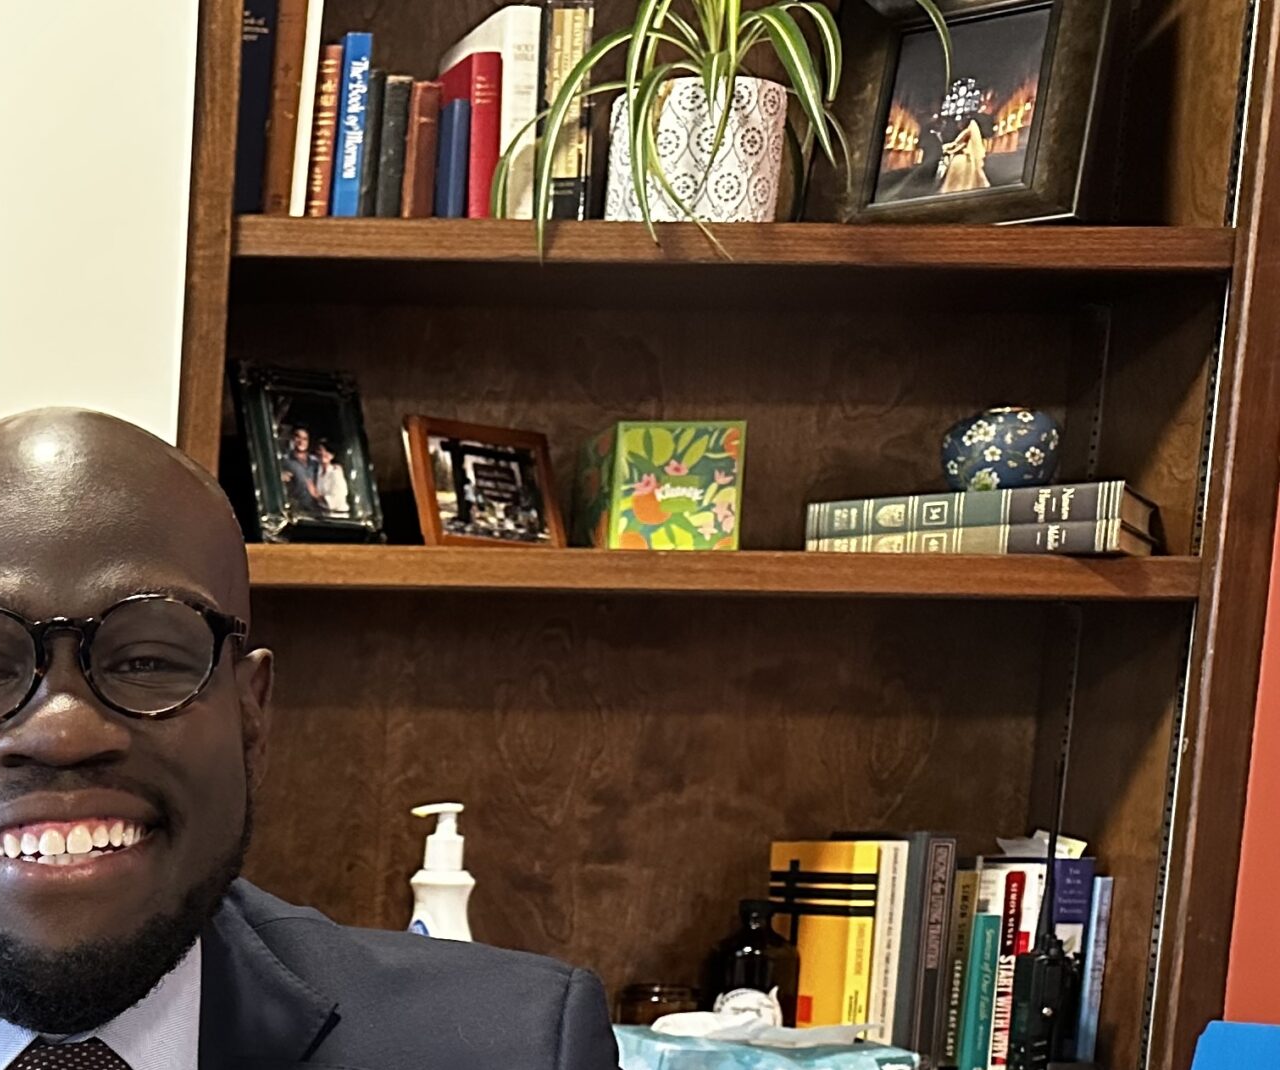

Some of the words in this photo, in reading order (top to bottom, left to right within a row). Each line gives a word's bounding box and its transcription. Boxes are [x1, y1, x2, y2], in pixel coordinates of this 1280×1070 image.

[349, 56, 369, 80] The
[346, 80, 368, 114] Book
[341, 130, 365, 180] Mormon
[928, 506, 942, 521] 34
[958, 884, 970, 919] SIMON
[1008, 882, 1018, 914] SIMON
[949, 959, 962, 1007] LEADERS
[997, 954, 1016, 993] START
[948, 1008, 959, 1029] EAT
[994, 994, 1013, 1029] WITH
[945, 1031, 956, 1058] LAST
[991, 1029, 1011, 1059] WHY
